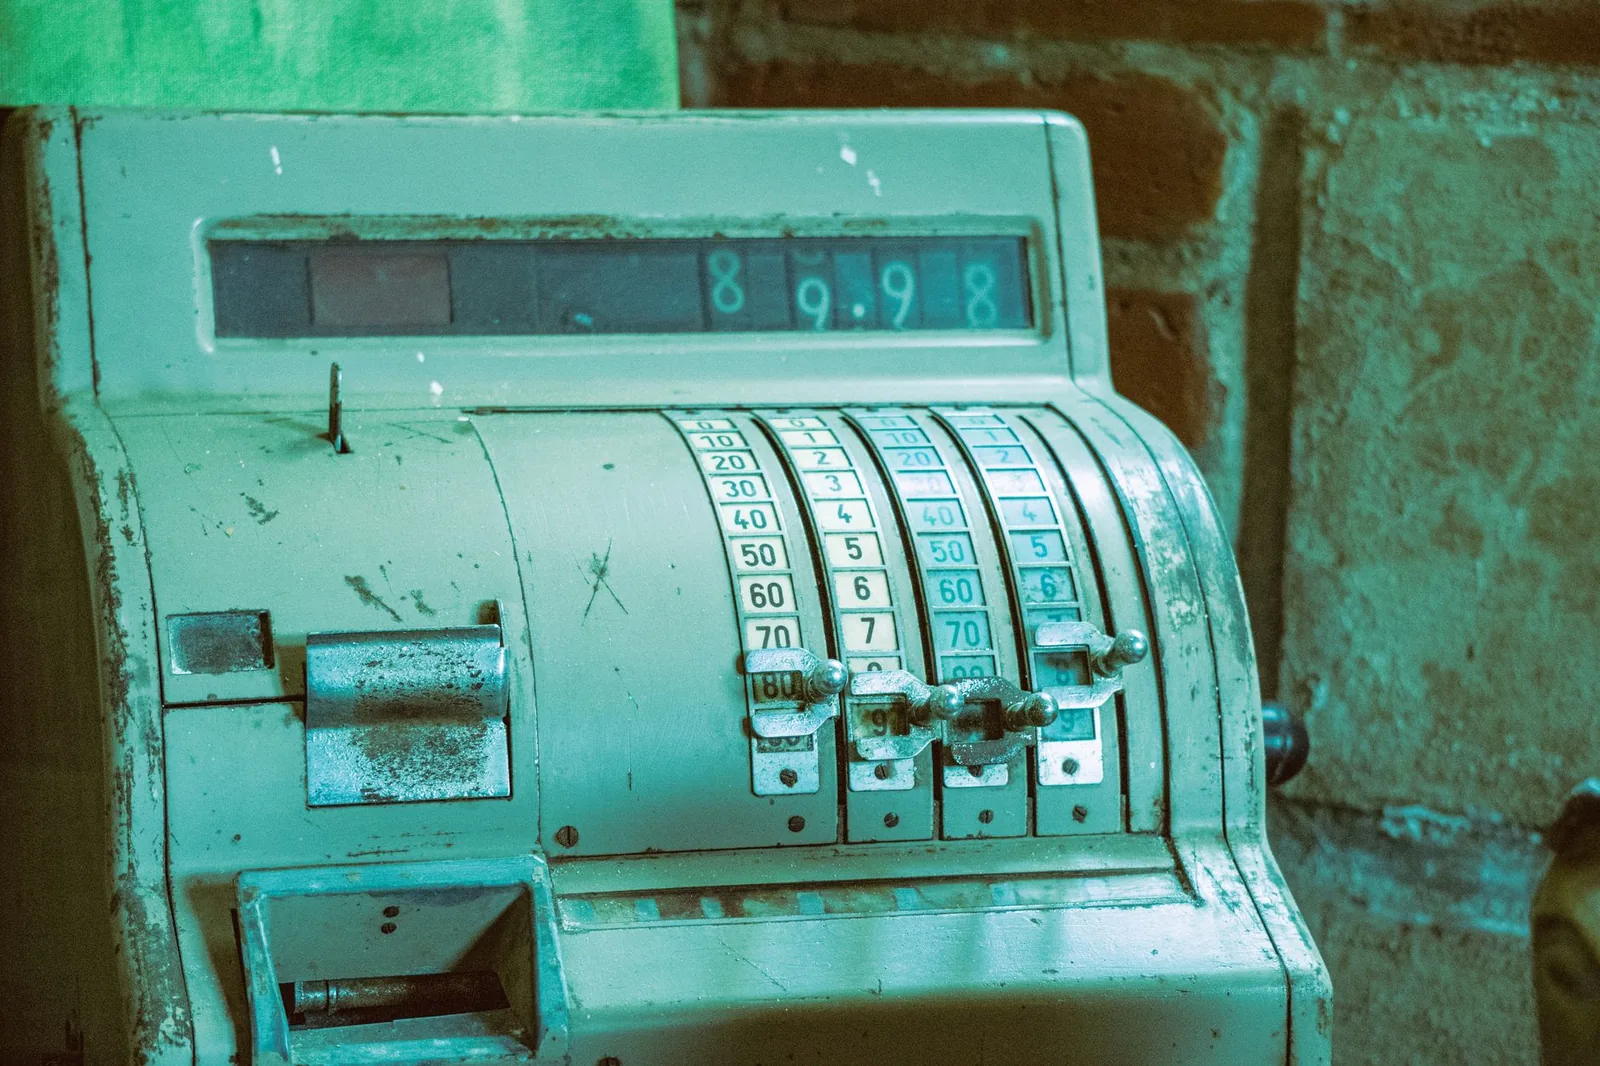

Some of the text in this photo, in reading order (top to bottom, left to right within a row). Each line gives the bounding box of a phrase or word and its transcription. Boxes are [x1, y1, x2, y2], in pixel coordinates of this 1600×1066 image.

[697, 421, 713, 430] 0
[789, 419, 805, 428] 0
[700, 434, 734, 448] 10
[803, 432, 816, 443] 1
[886, 431, 919, 444] 10
[985, 430, 998, 442] 1
[711, 455, 746, 470] 20
[812, 451, 831, 465] 2
[897, 451, 932, 466] 20
[996, 449, 1014, 464] 2
[722, 480, 757, 498] 30
[824, 475, 842, 492] 3
[734, 509, 767, 529] 40
[837, 503, 852, 524] 4
[922, 506, 955, 526] 40
[1022, 502, 1037, 523] 4
[740, 543, 776, 567] 50
[844, 537, 863, 560] 5
[929, 541, 965, 563] 50
[1030, 535, 1048, 558] 5
[750, 582, 784, 608] 60
[854, 576, 871, 601] 6
[939, 578, 973, 603] 60
[1040, 573, 1057, 600] 6
[756, 625, 791, 649] 70
[860, 617, 875, 644] 7
[945, 620, 981, 648] 70
[763, 672, 797, 699] 80
[871, 709, 887, 736] 9
